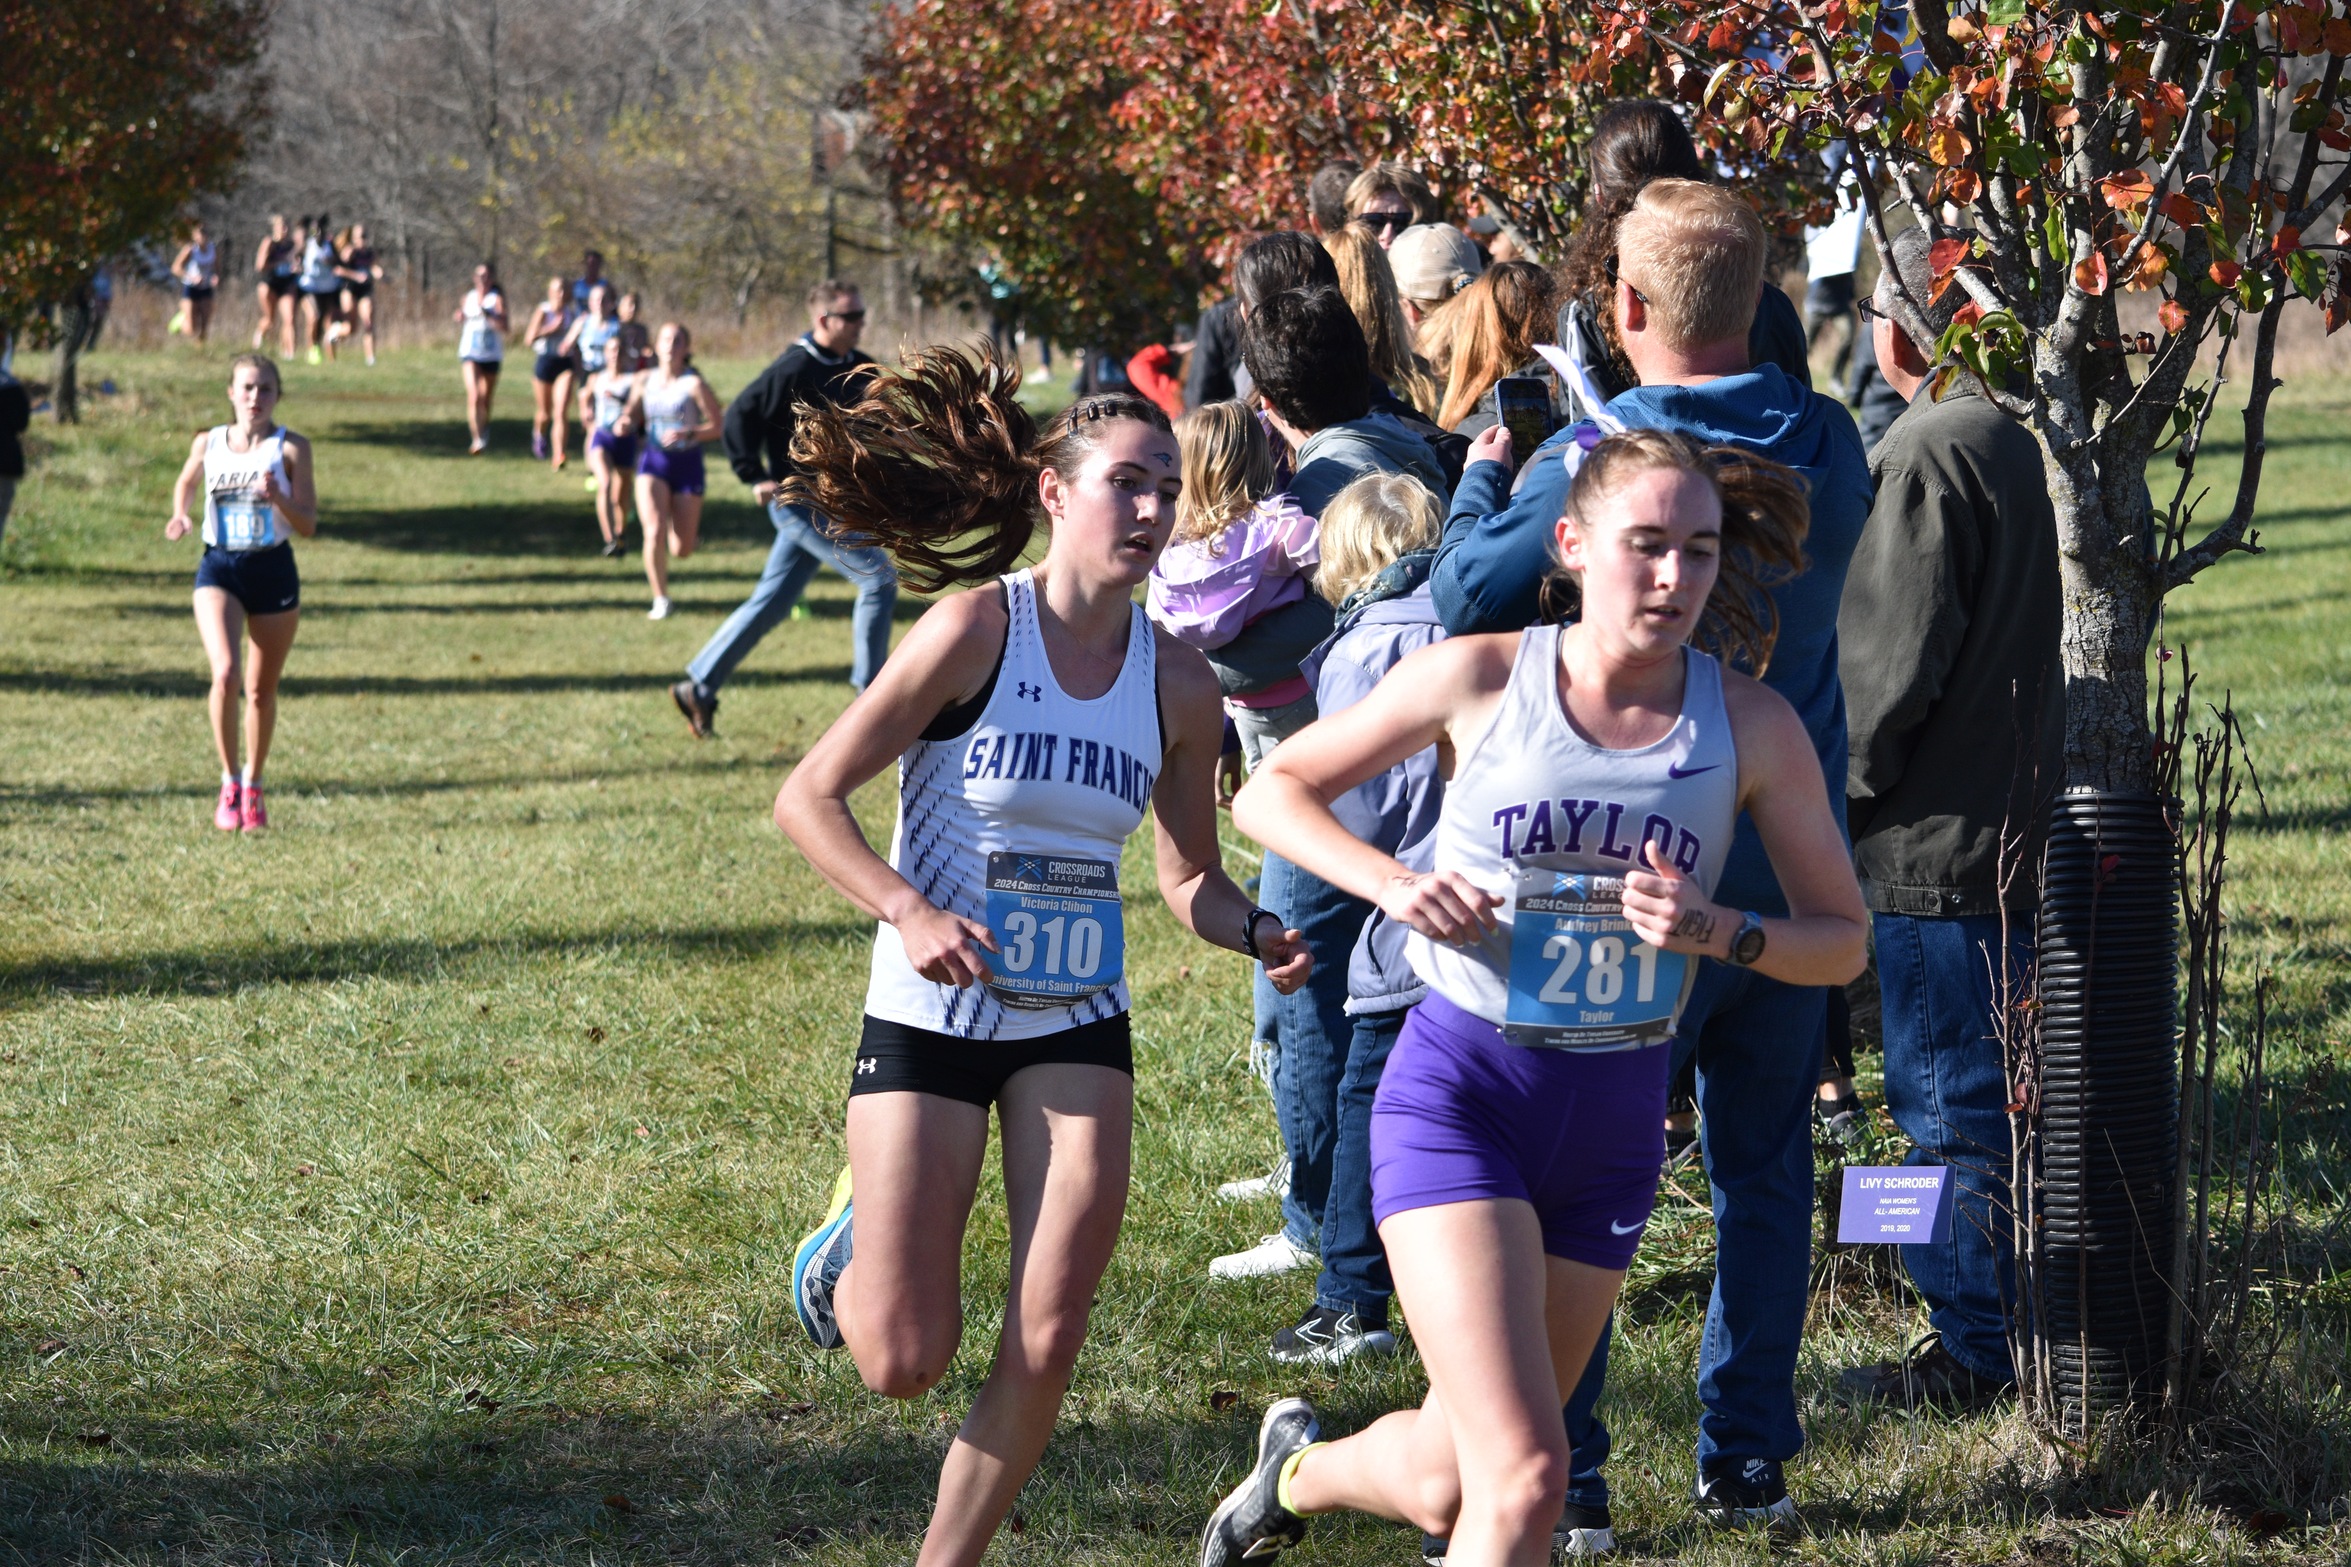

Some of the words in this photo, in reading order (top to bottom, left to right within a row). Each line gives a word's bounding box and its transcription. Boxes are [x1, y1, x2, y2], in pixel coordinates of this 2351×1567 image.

[964, 732, 1058, 781] SAINT
[1048, 861, 1106, 878] CROSSROADS
[994, 878, 1018, 889] 2024
[1047, 874, 1087, 883] LEAGUE
[1593, 876, 1627, 892] CROS
[1592, 891, 1623, 899] LEAG
[1021, 896, 1059, 911] Victoria
[1061, 901, 1093, 914] Clibon
[1525, 898, 1553, 909] 2024
[1555, 917, 1599, 934] Audrey
[1600, 918, 1633, 932] Brink
[1004, 911, 1103, 978] 310
[1538, 935, 1658, 1005] 281
[992, 975, 1034, 990] niversity
[1036, 981, 1047, 990] of
[1048, 981, 1073, 993] Saint
[1580, 1010, 1615, 1023] Taylor
[1860, 1178, 1882, 1188] LIVY
[1884, 1178, 1939, 1188] SCHRODER
[1880, 1225, 1896, 1233] 2019,
[1746, 1459, 1765, 1469] NIKE
[1751, 1473, 1769, 1483] AIR
